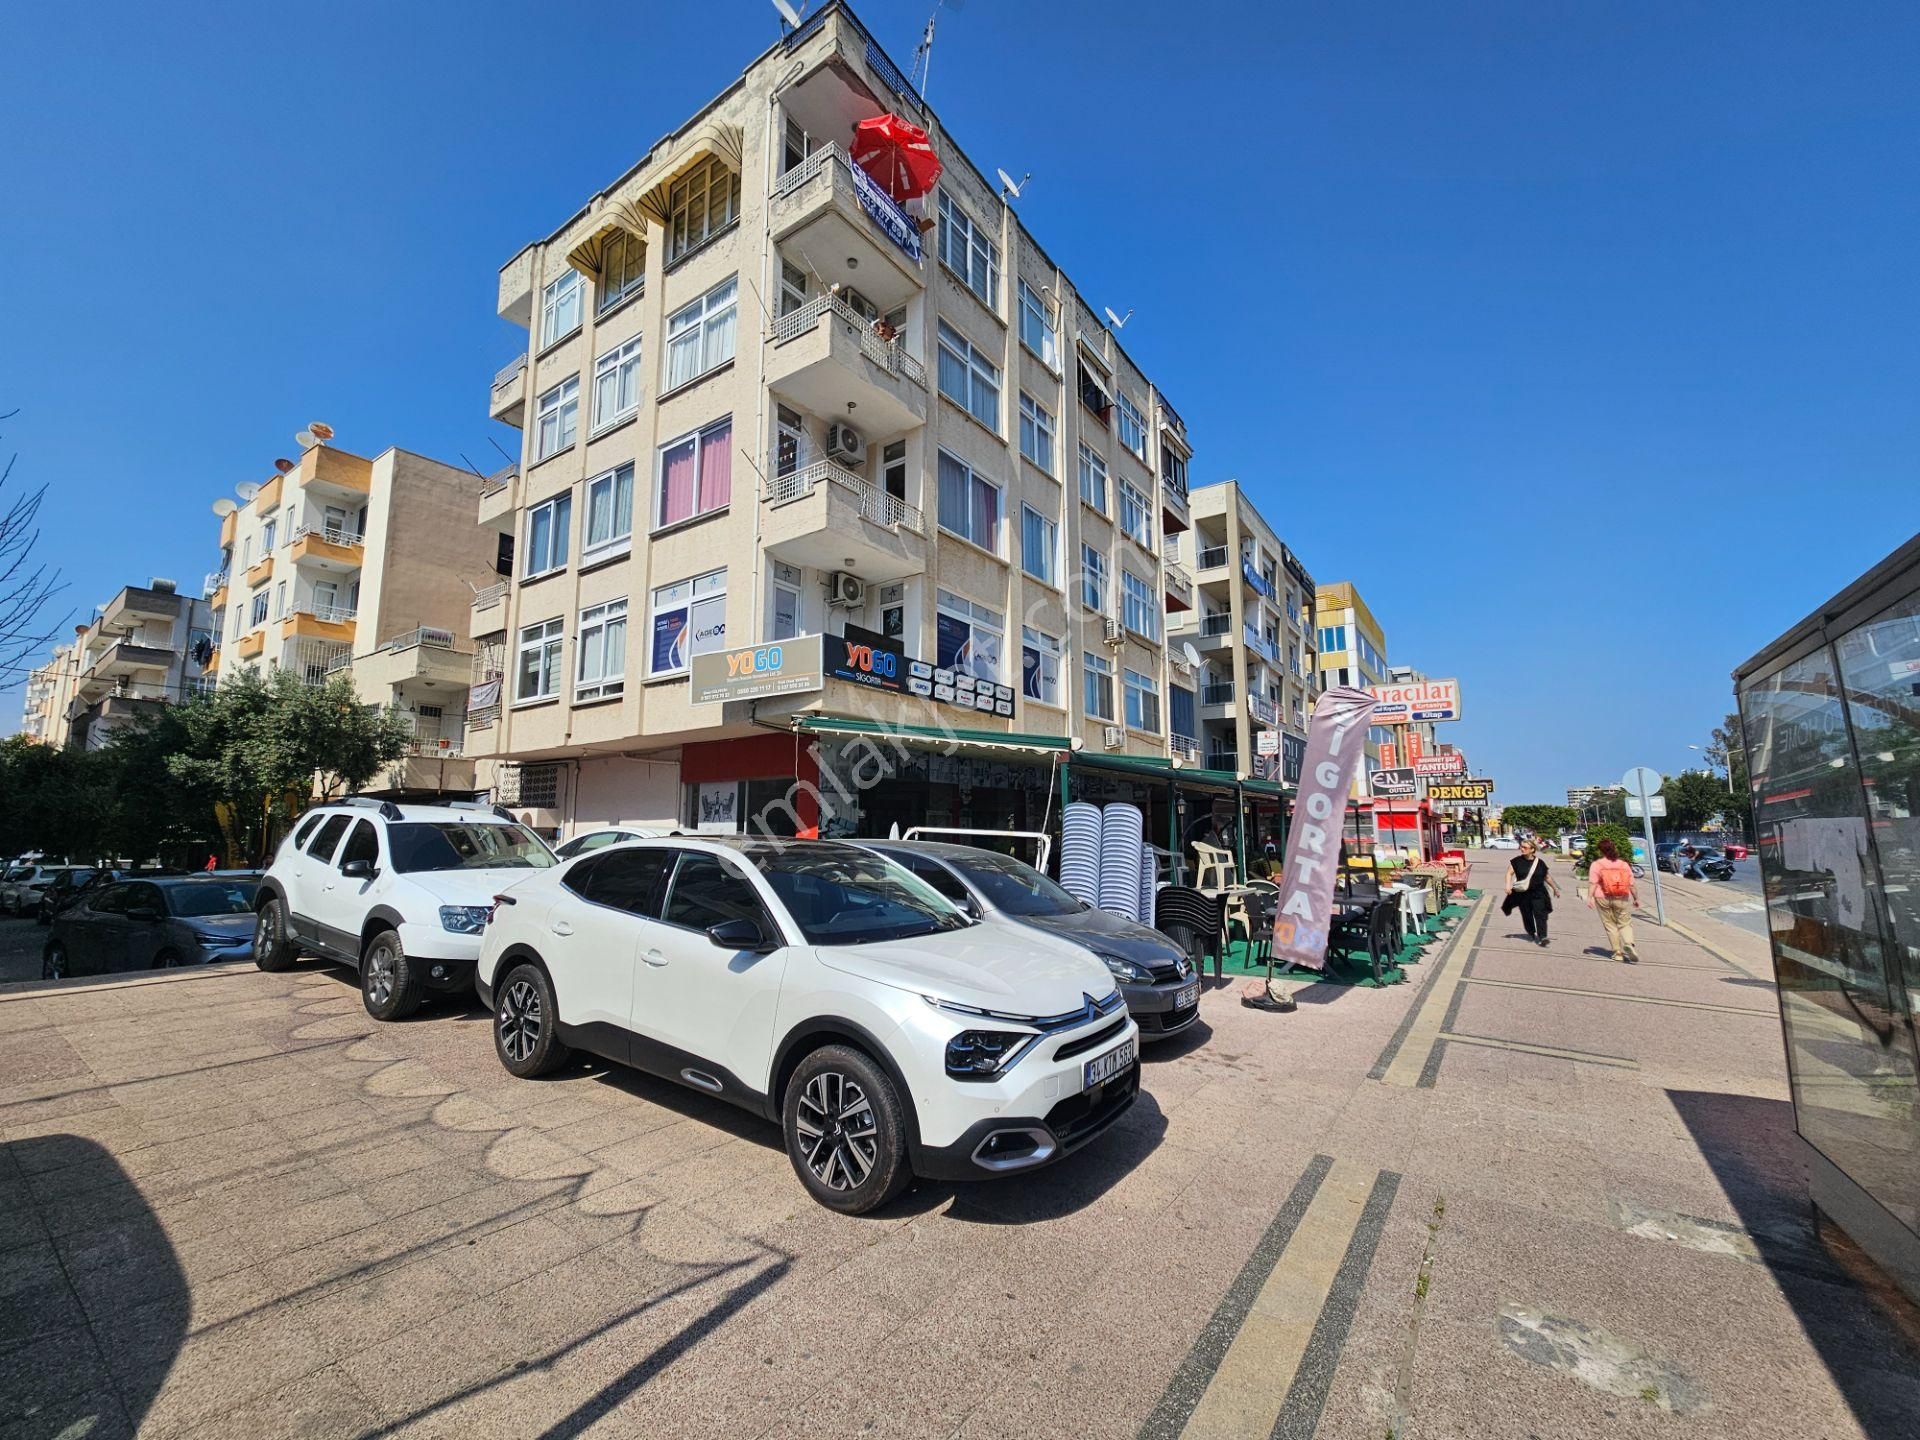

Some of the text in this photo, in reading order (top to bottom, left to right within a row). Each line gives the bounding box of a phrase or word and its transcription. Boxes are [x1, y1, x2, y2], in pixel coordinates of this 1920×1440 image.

[726, 646, 784, 677] YOGO
[846, 641, 896, 678] YOGO
[1422, 711, 1443, 719] Kitap
[1389, 786, 1416, 794] OUTLET
[1429, 786, 1486, 799] DENGE
[1091, 1061, 1100, 1084] 34
[1104, 1051, 1117, 1077] KTM
